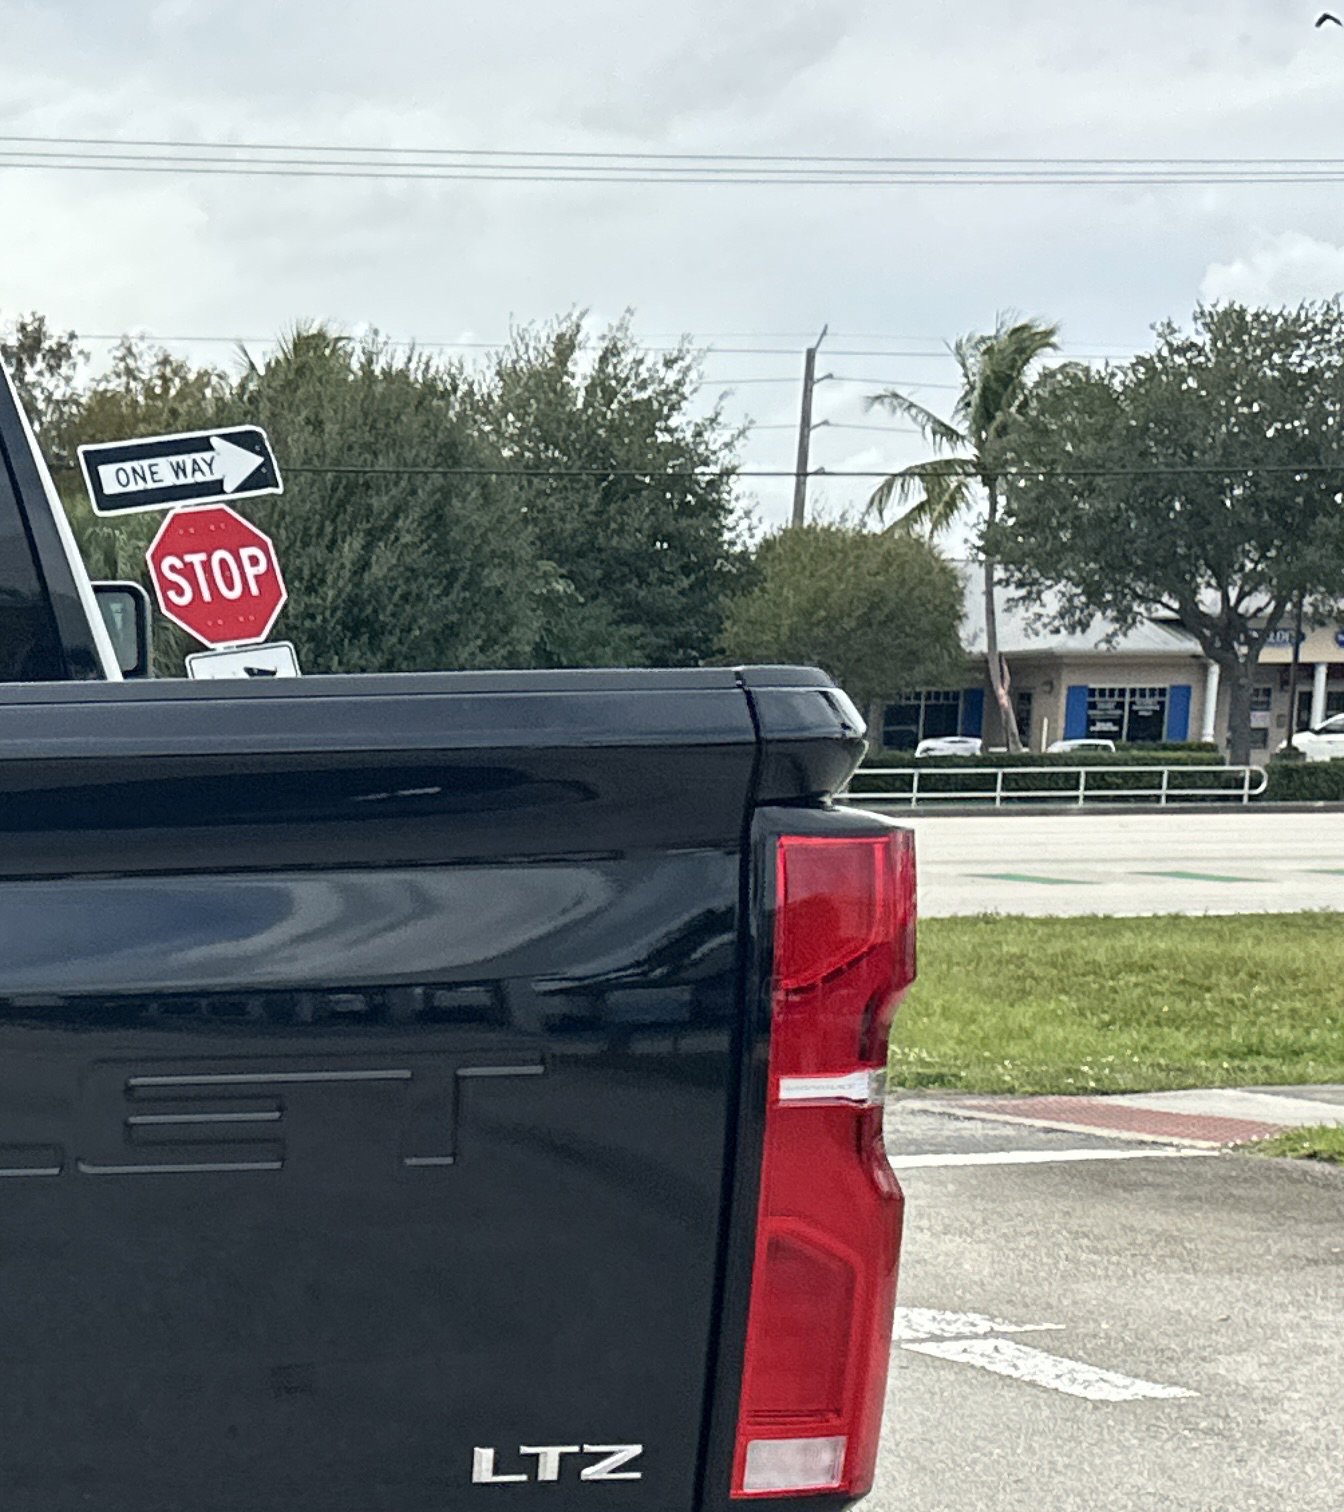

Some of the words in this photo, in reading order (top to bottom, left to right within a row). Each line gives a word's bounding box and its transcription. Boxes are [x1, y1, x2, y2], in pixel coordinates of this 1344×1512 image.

[115, 461, 164, 489] ONE
[169, 455, 216, 481] WAY
[160, 546, 268, 607] STOP
[471, 1443, 644, 1484] LTZ
